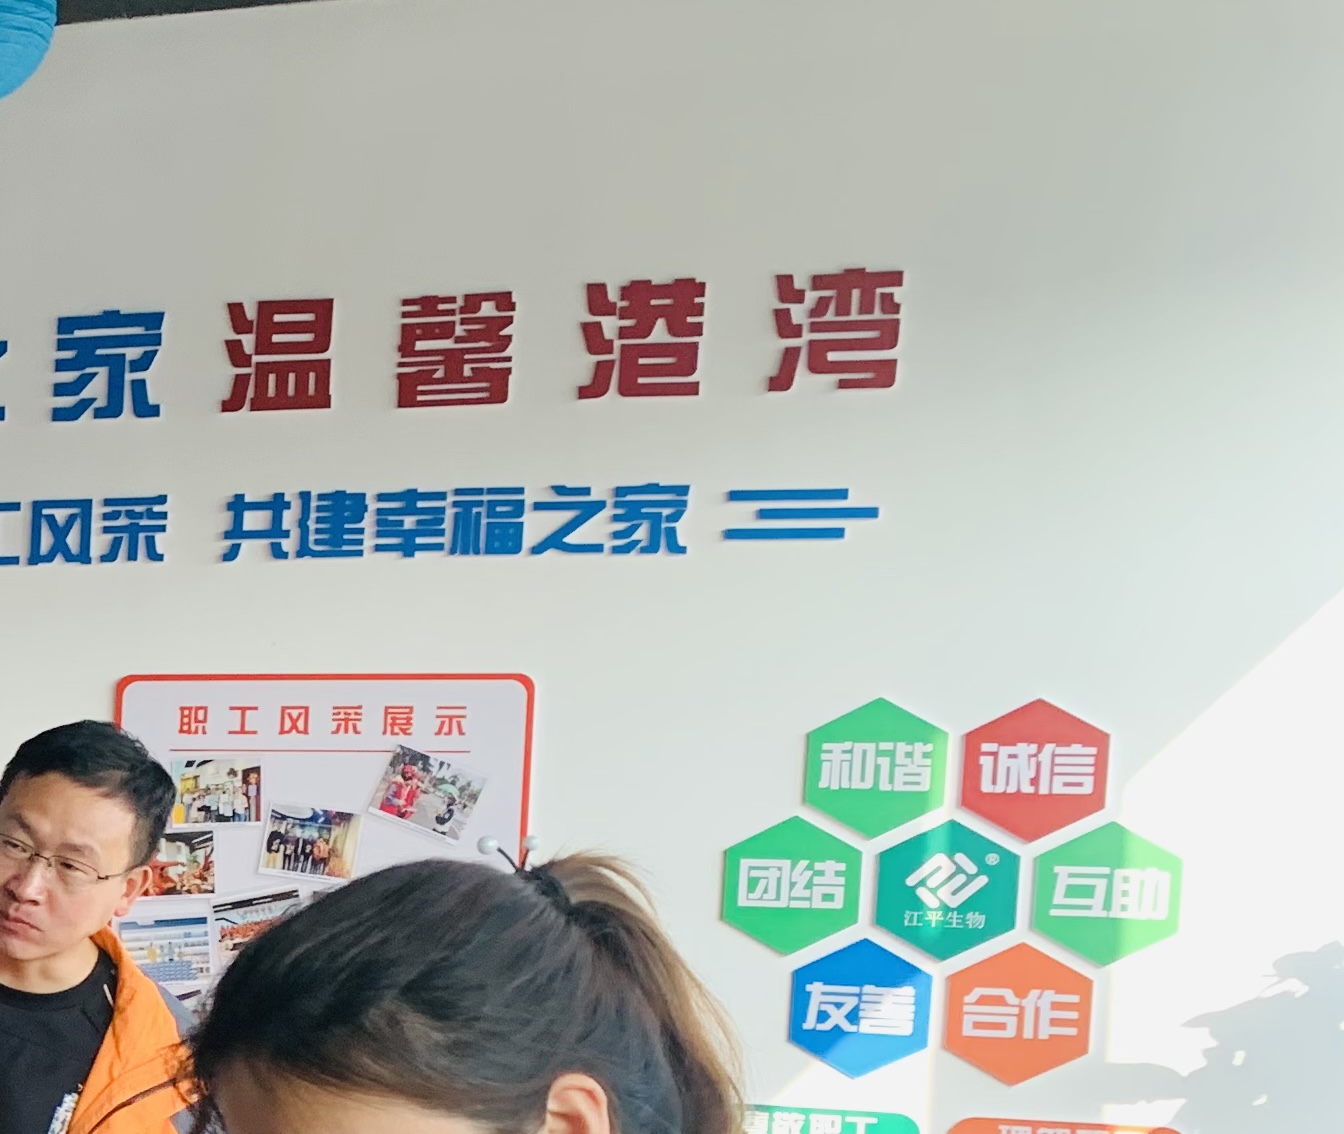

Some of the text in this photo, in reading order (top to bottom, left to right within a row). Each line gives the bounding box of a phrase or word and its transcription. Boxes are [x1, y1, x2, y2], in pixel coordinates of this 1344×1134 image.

[221, 269, 904, 413] 温馨港湾
[222, 482, 693, 563] 共建幸福之家
[178, 705, 467, 737] 职工风采展示
[818, 740, 934, 793] 和谐
[978, 742, 1099, 796] 诚信
[736, 858, 847, 910] 团结
[1048, 864, 1172, 921] 互助
[903, 909, 986, 930] 江平生物
[802, 981, 916, 1037] 友善
[961, 986, 1081, 1041] 合作
